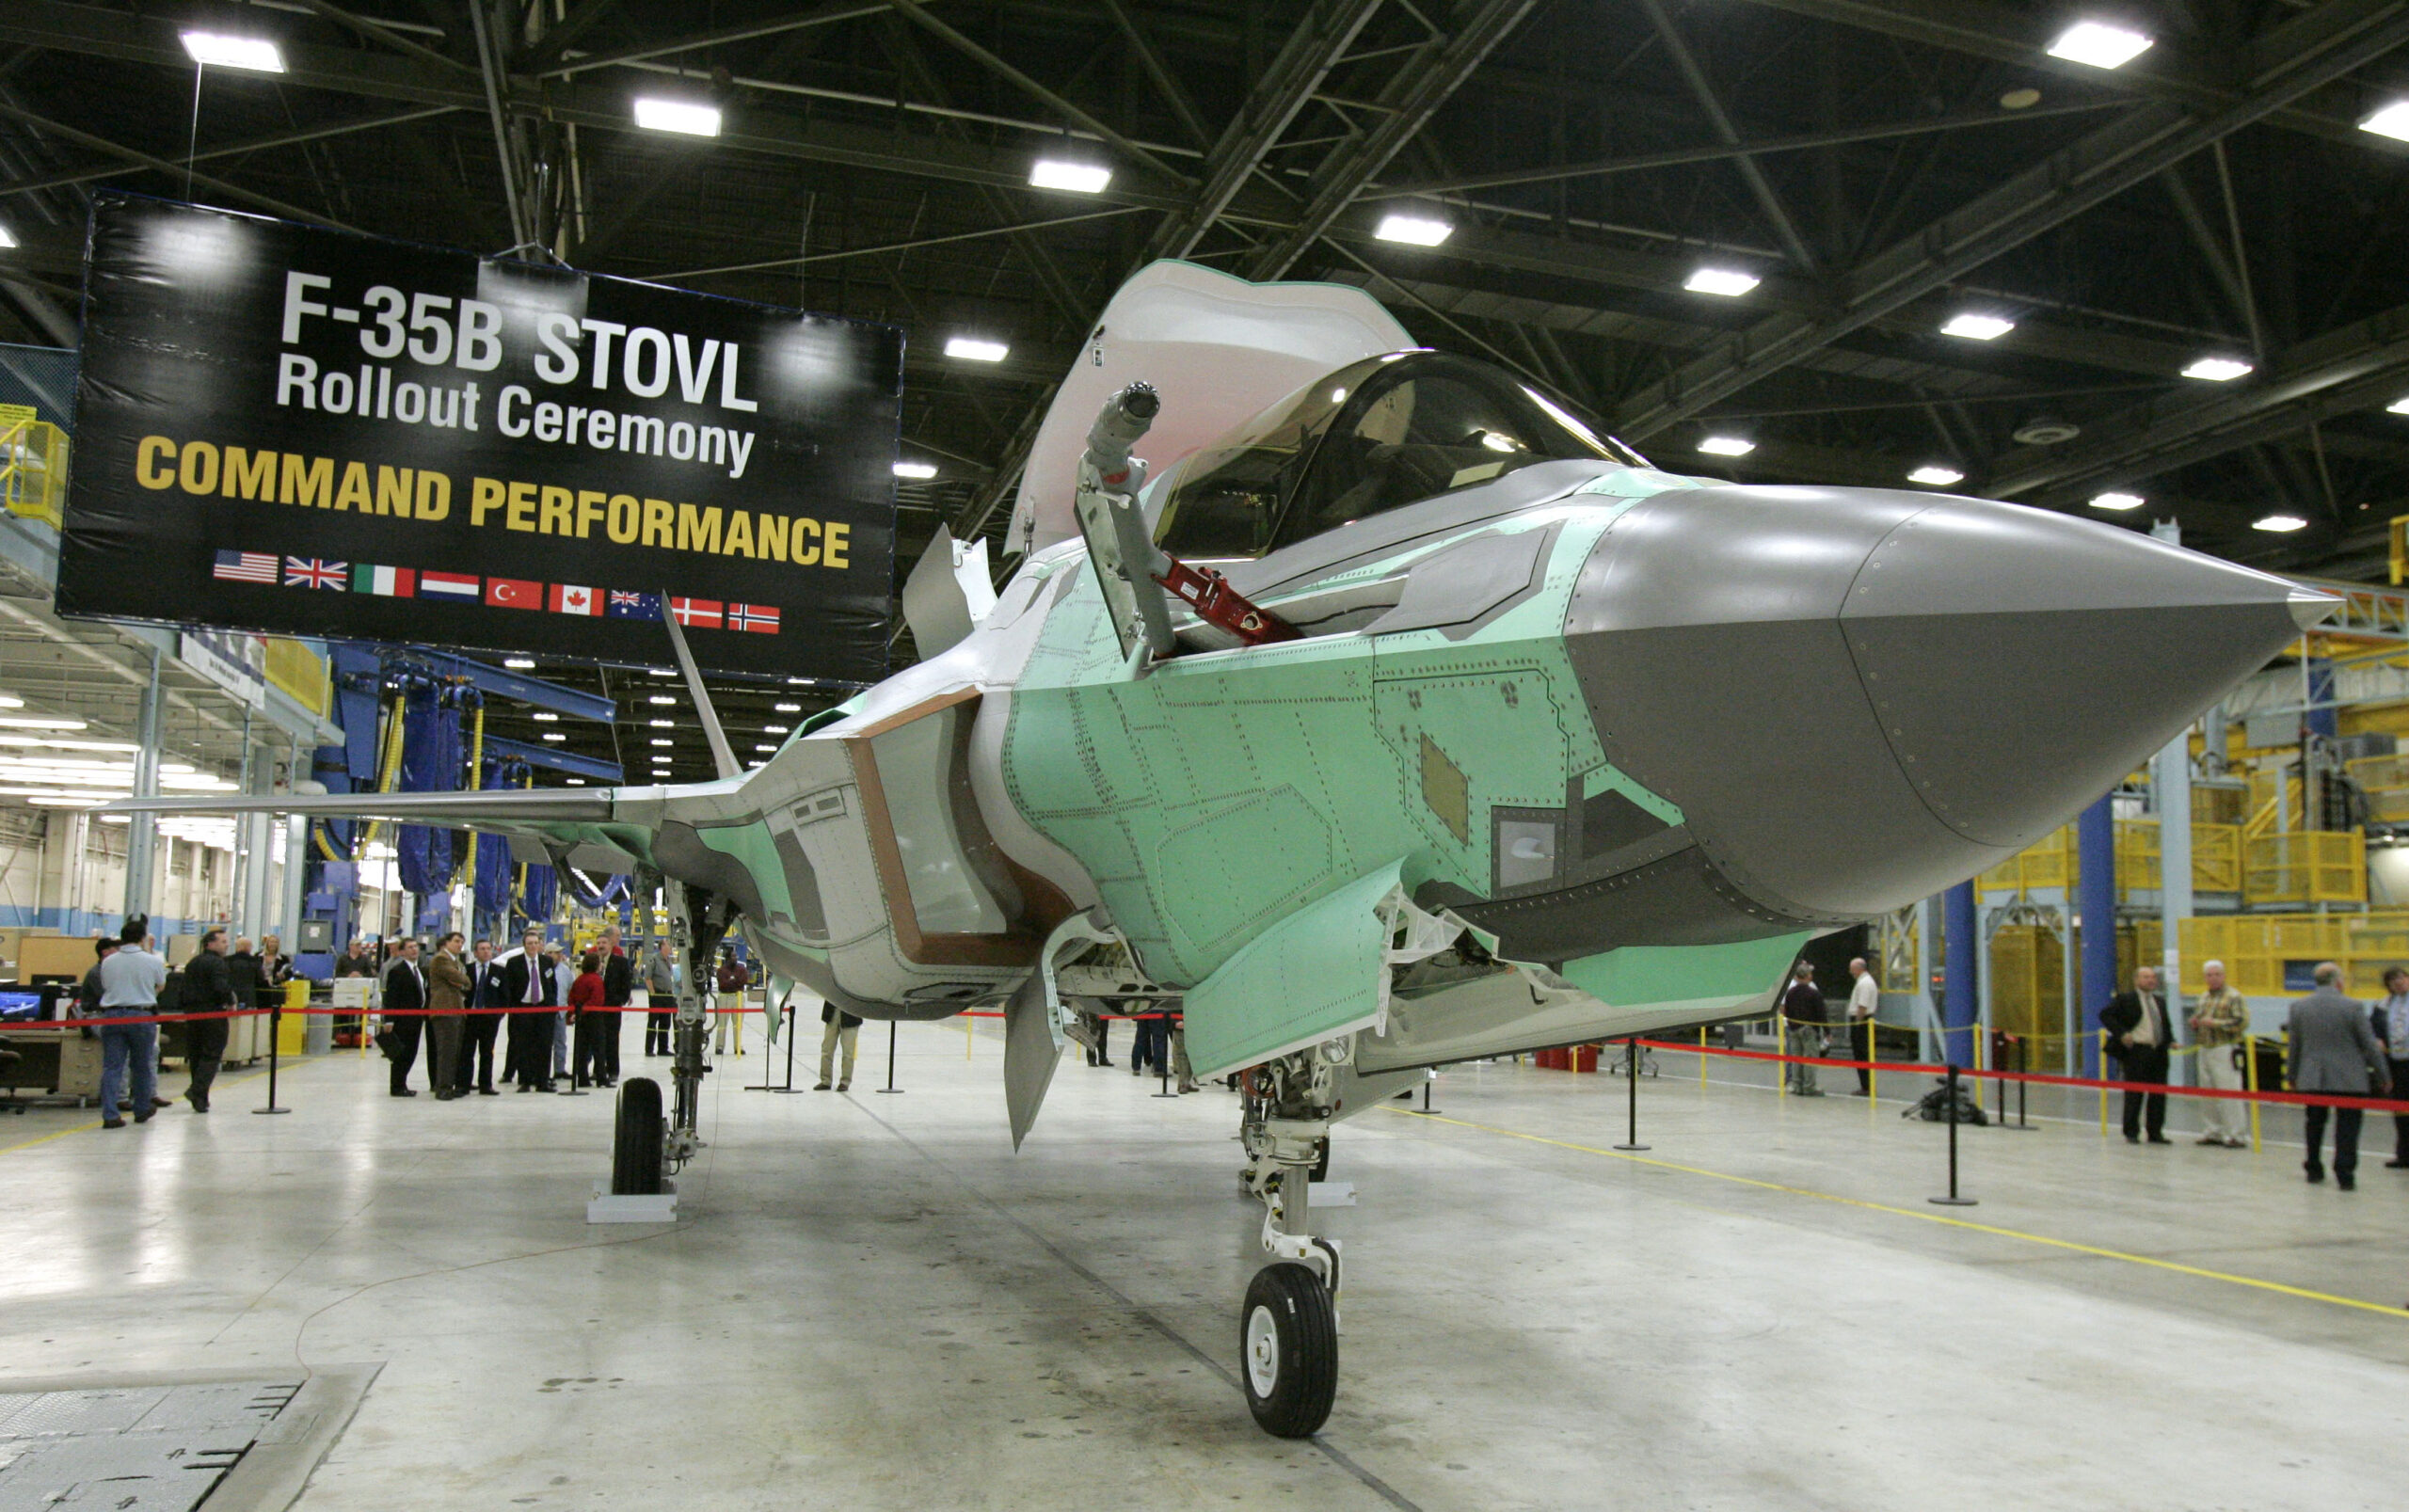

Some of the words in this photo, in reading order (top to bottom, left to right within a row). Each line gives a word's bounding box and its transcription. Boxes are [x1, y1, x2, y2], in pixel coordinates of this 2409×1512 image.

[282, 270, 502, 372] F-35B
[534, 312, 758, 412] STOVL
[277, 352, 480, 431] Rollout
[498, 384, 756, 479] Ceremony
[136, 436, 451, 521] COMMAND
[471, 477, 850, 569] PERFORMANCE
